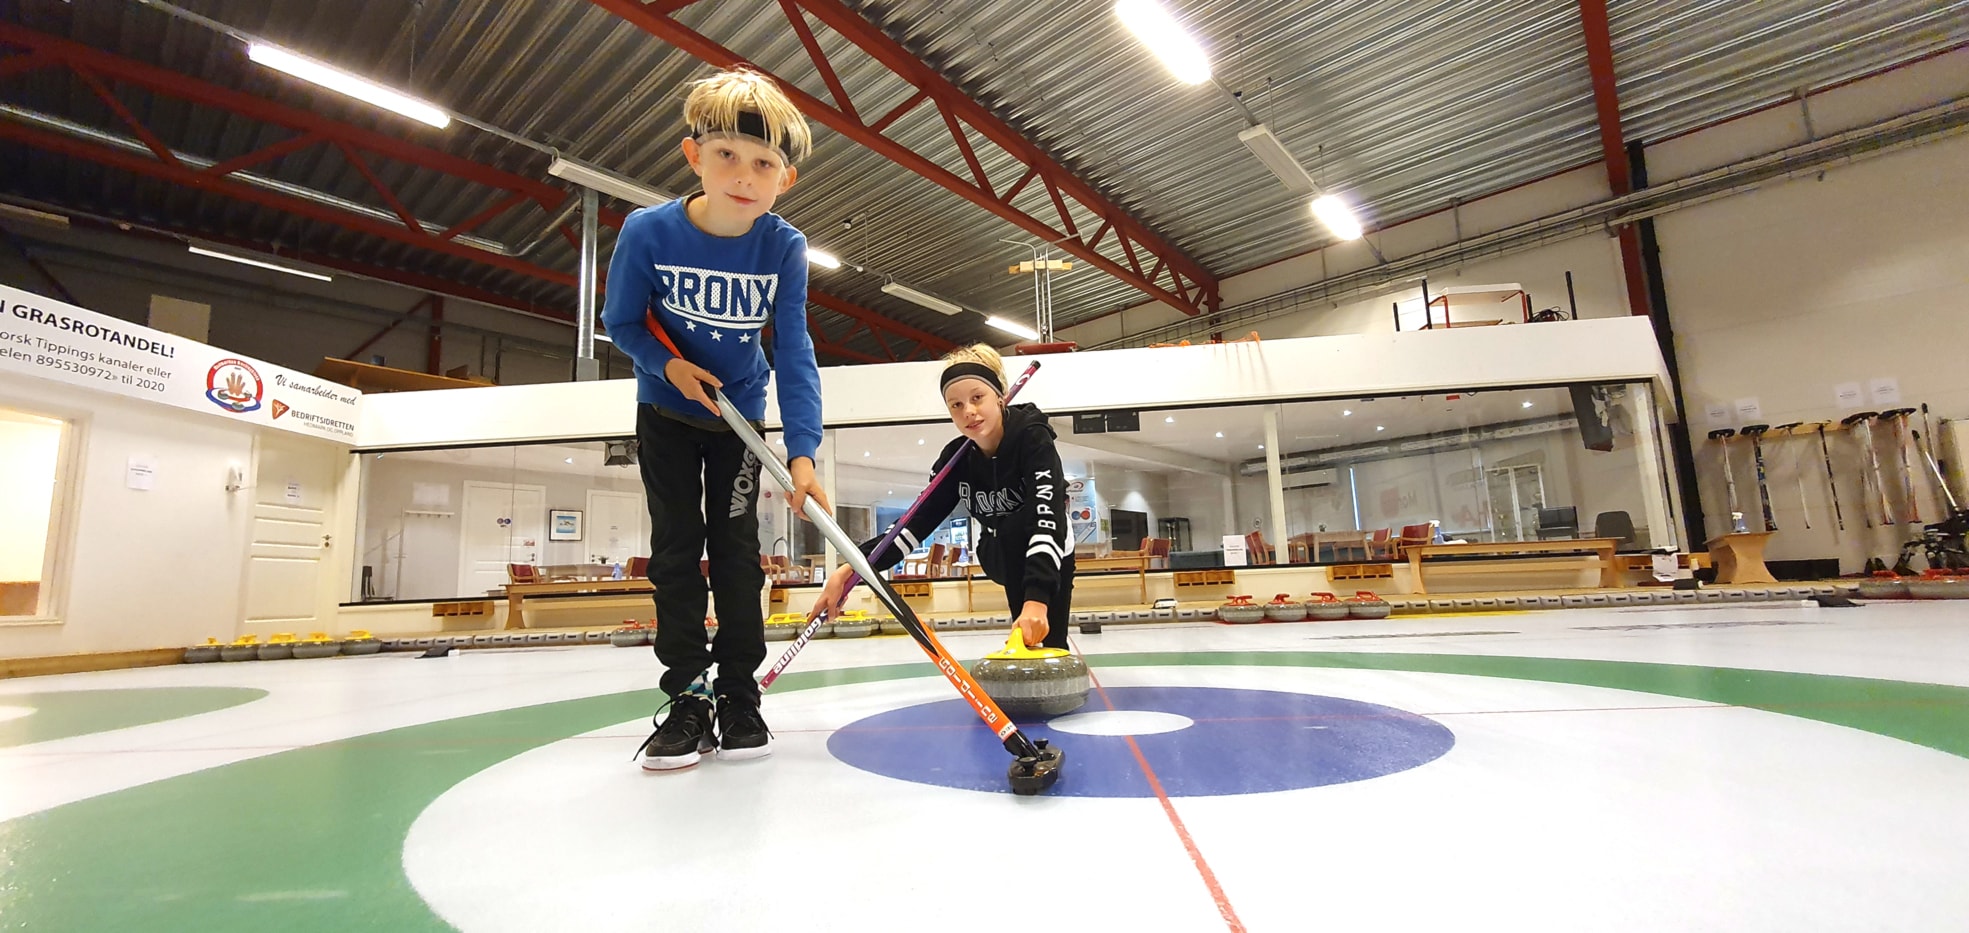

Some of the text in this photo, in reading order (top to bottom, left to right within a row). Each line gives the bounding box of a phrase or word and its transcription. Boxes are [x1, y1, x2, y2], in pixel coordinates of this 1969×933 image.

[656, 269, 773, 318] BRONX
[12, 304, 175, 358] GRASROTANDEL!
[36, 337, 95, 362] Tippings
[99, 352, 147, 373] kanaler
[146, 367, 172, 380] eller
[121, 374, 133, 385] til
[136, 378, 165, 392] 2020
[275, 374, 357, 406] Vi samarbeider med
[291, 410, 355, 431] BEDRIFTSIDRETTEN
[1034, 469, 1057, 531] BRONX
[773, 616, 822, 674] Goldline
[938, 656, 998, 724] Goldline
